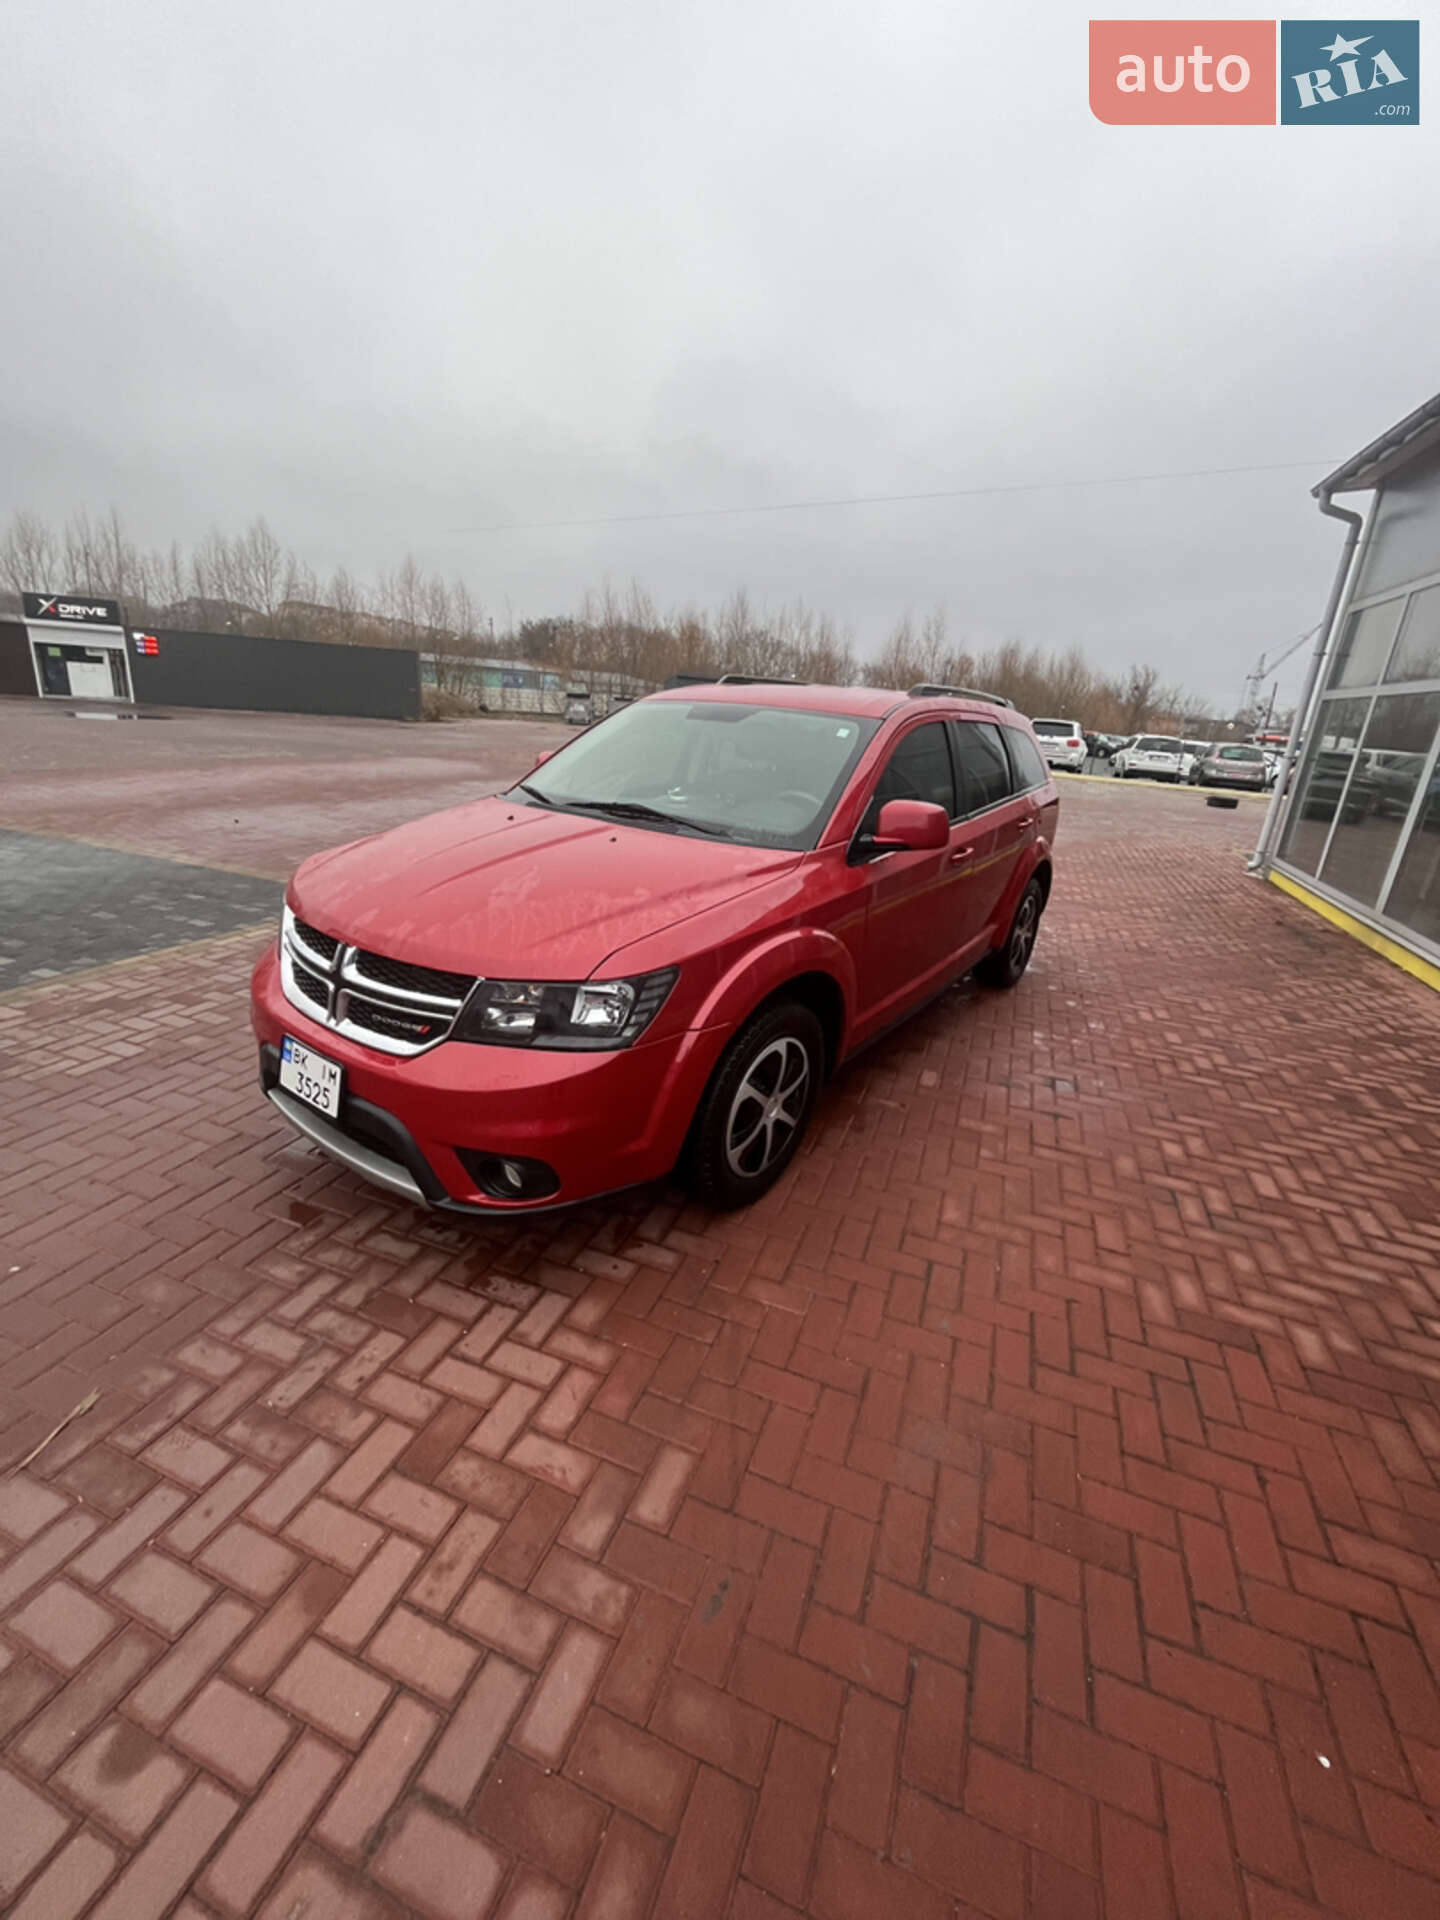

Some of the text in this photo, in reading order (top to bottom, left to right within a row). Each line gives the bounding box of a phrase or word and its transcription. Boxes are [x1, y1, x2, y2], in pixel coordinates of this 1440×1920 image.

[58, 603, 108, 618] DRIVE
[293, 1048, 309, 1071] BK
[296, 1071, 331, 1109] 3525
